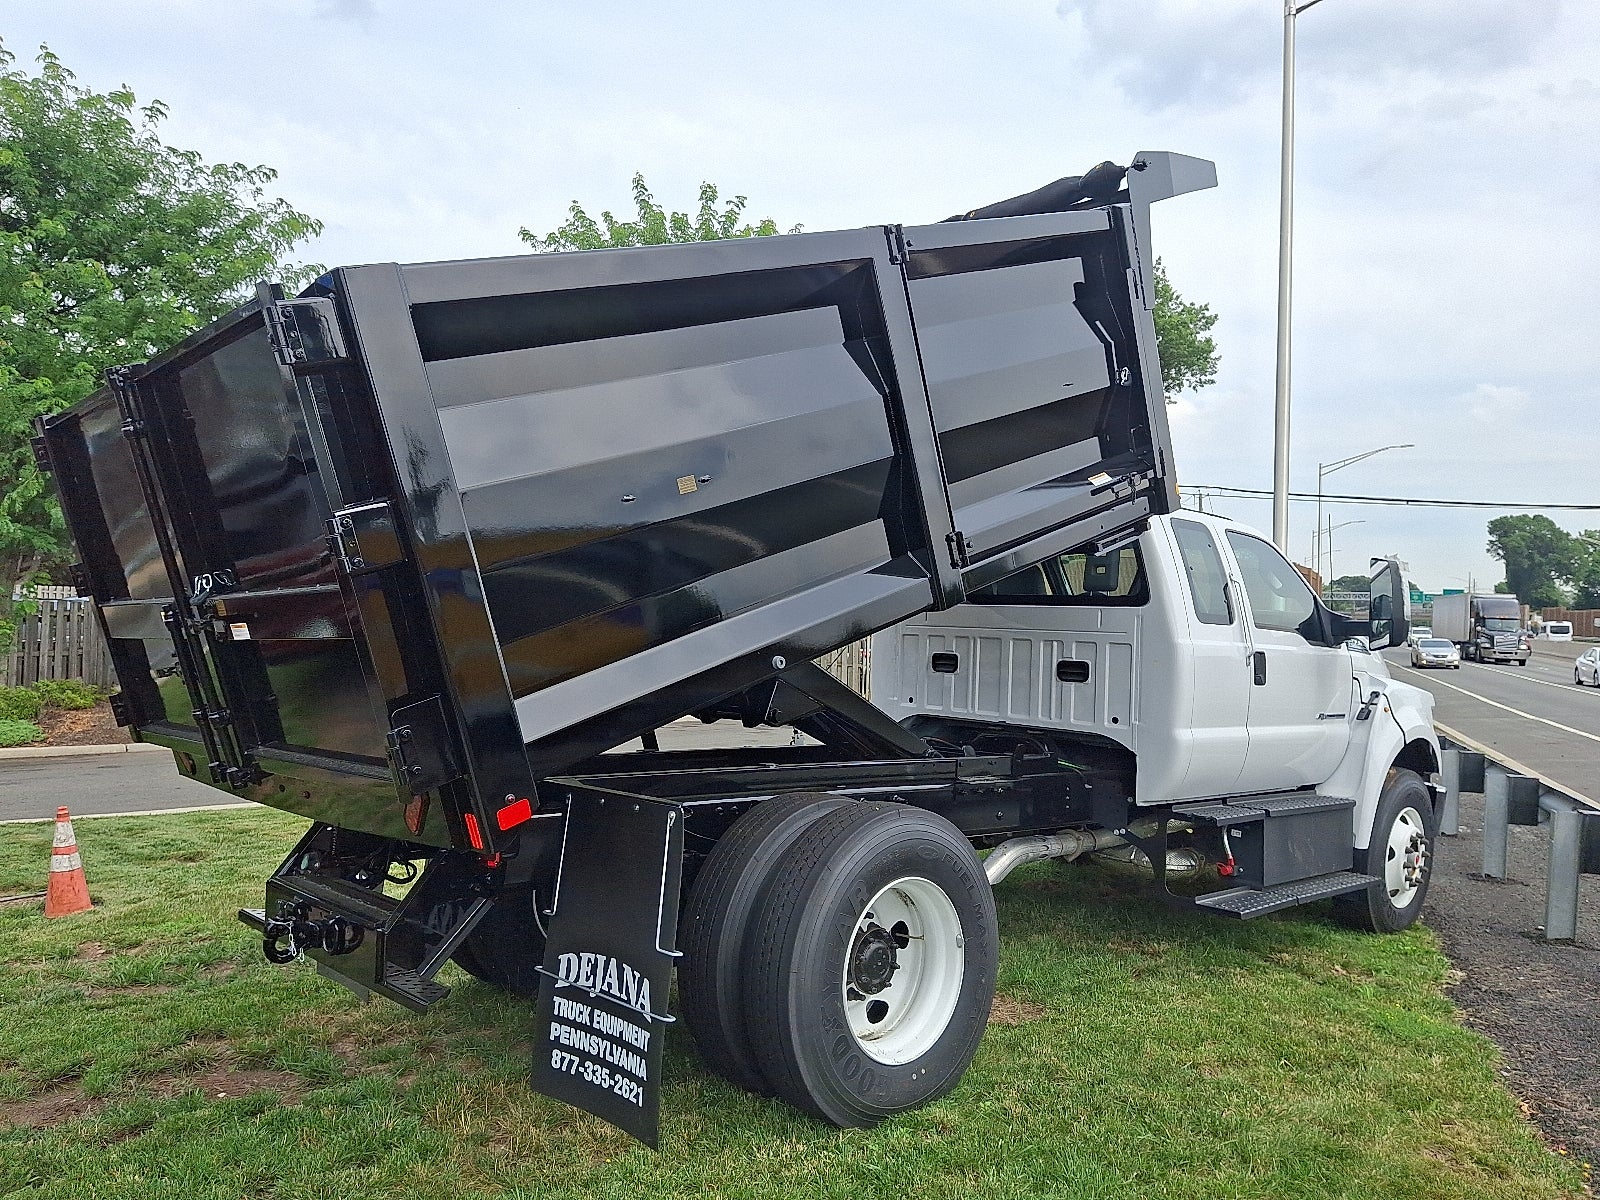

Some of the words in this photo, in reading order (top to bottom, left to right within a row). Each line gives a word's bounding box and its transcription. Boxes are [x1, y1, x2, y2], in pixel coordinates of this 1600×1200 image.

[941, 852, 976, 900] FUEL
[554, 951, 652, 1024] DEJANA
[549, 1021, 648, 1082] PENNSYLVANIA
[552, 995, 591, 1026] TRUCK
[592, 1008, 651, 1052] EQUIPMENT
[550, 1049, 645, 1108] 877-335-2621
